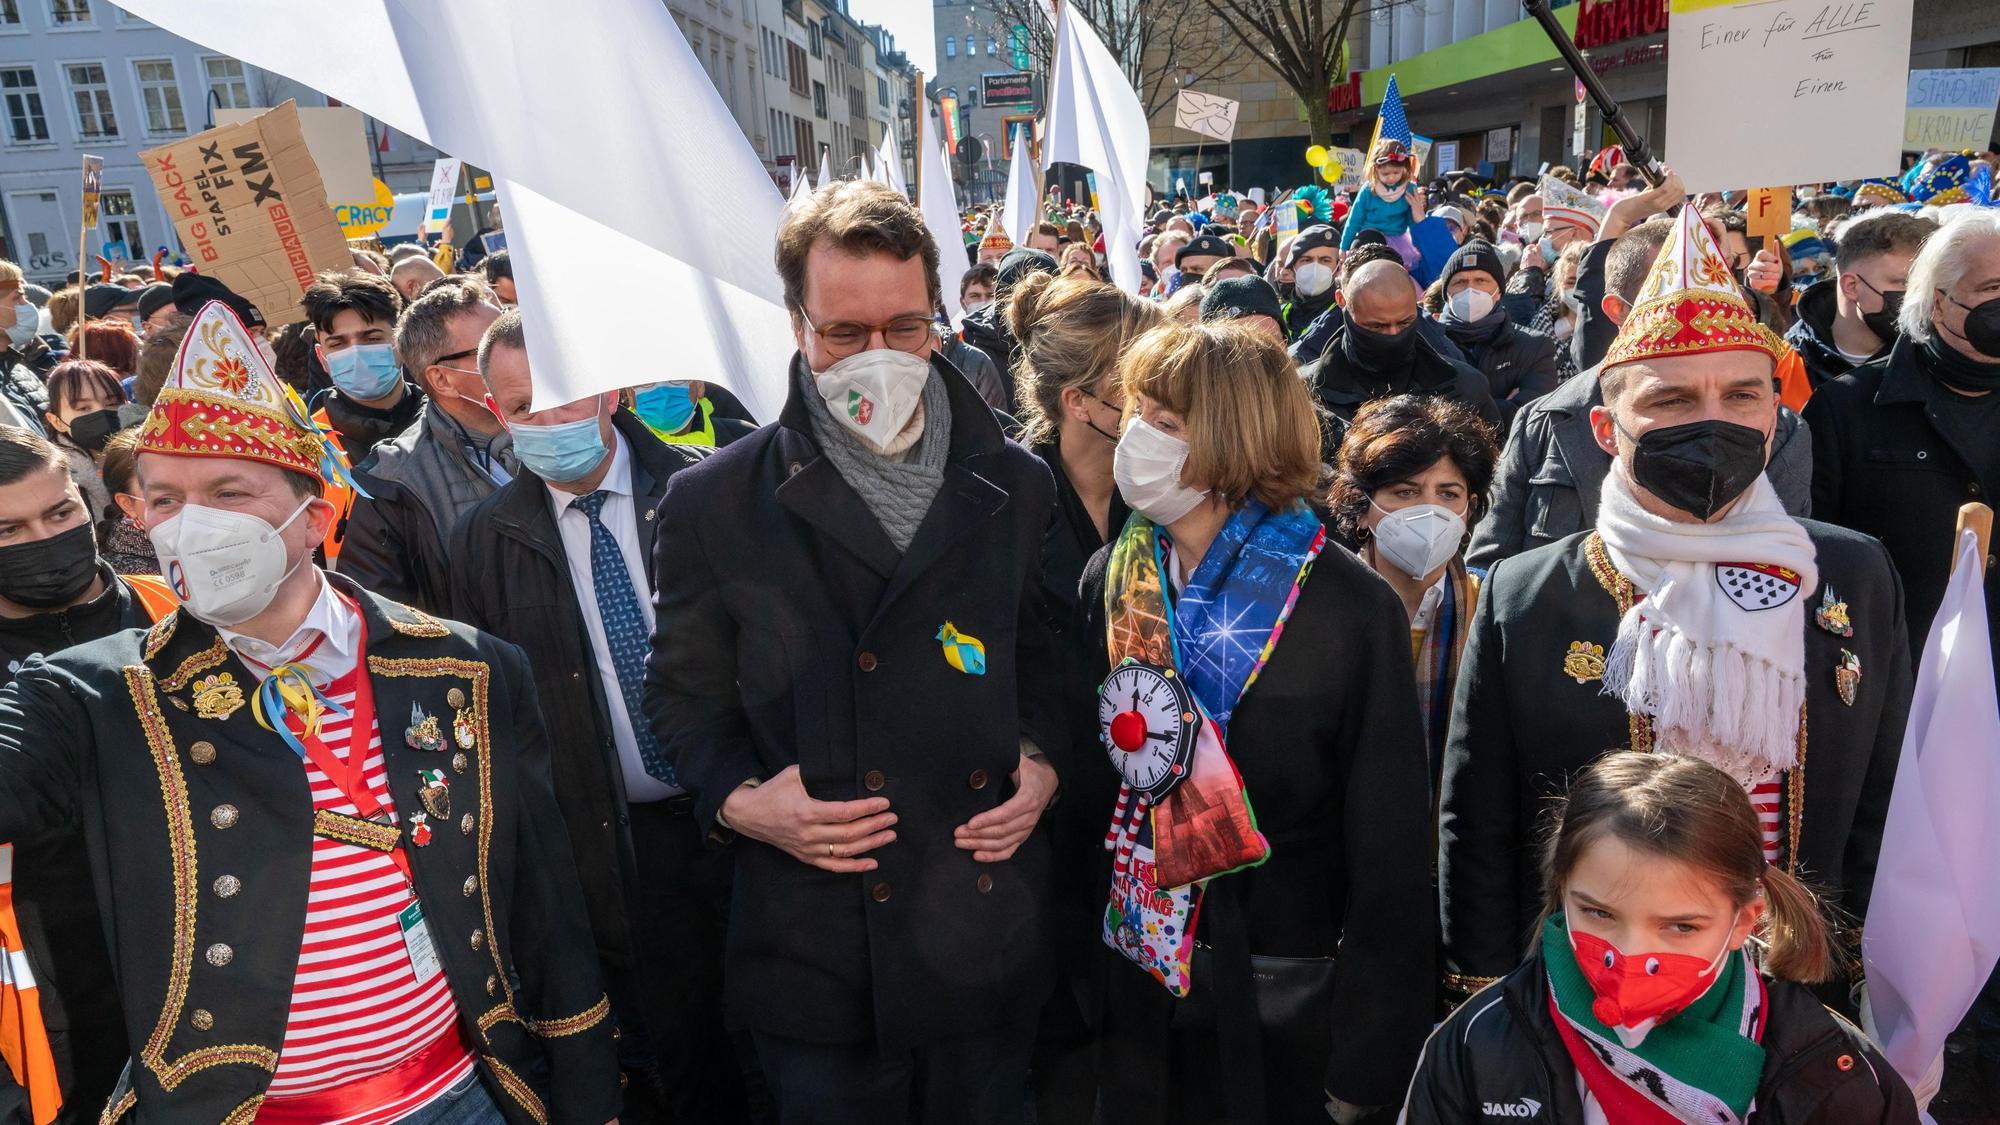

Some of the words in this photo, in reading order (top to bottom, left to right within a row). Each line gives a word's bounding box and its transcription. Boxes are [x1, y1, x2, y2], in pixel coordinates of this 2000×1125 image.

[1575, 0, 1668, 49] ALNATU
[1701, 23, 1750, 50] Einer
[1803, 2, 1876, 33] ALLE
[988, 77, 1028, 86] Parfümerie
[1793, 78, 1848, 98] Einen
[1914, 77, 1968, 104] STAND
[1905, 113, 1990, 143] UKRAINE
[198, 140, 234, 189] FIX
[232, 141, 284, 207] XM
[156, 153, 198, 217] PACK
[194, 169, 231, 237] STAPEL
[335, 205, 394, 227] CRACY
[191, 222, 218, 263] BIG
[268, 203, 316, 293] UHAUS
[1111, 703, 1118, 713] 9
[1142, 693, 1153, 707] 12
[1152, 745, 1159, 757] 3
[1135, 886, 1174, 917] SING
[1482, 1102, 1530, 1117] JAKO
